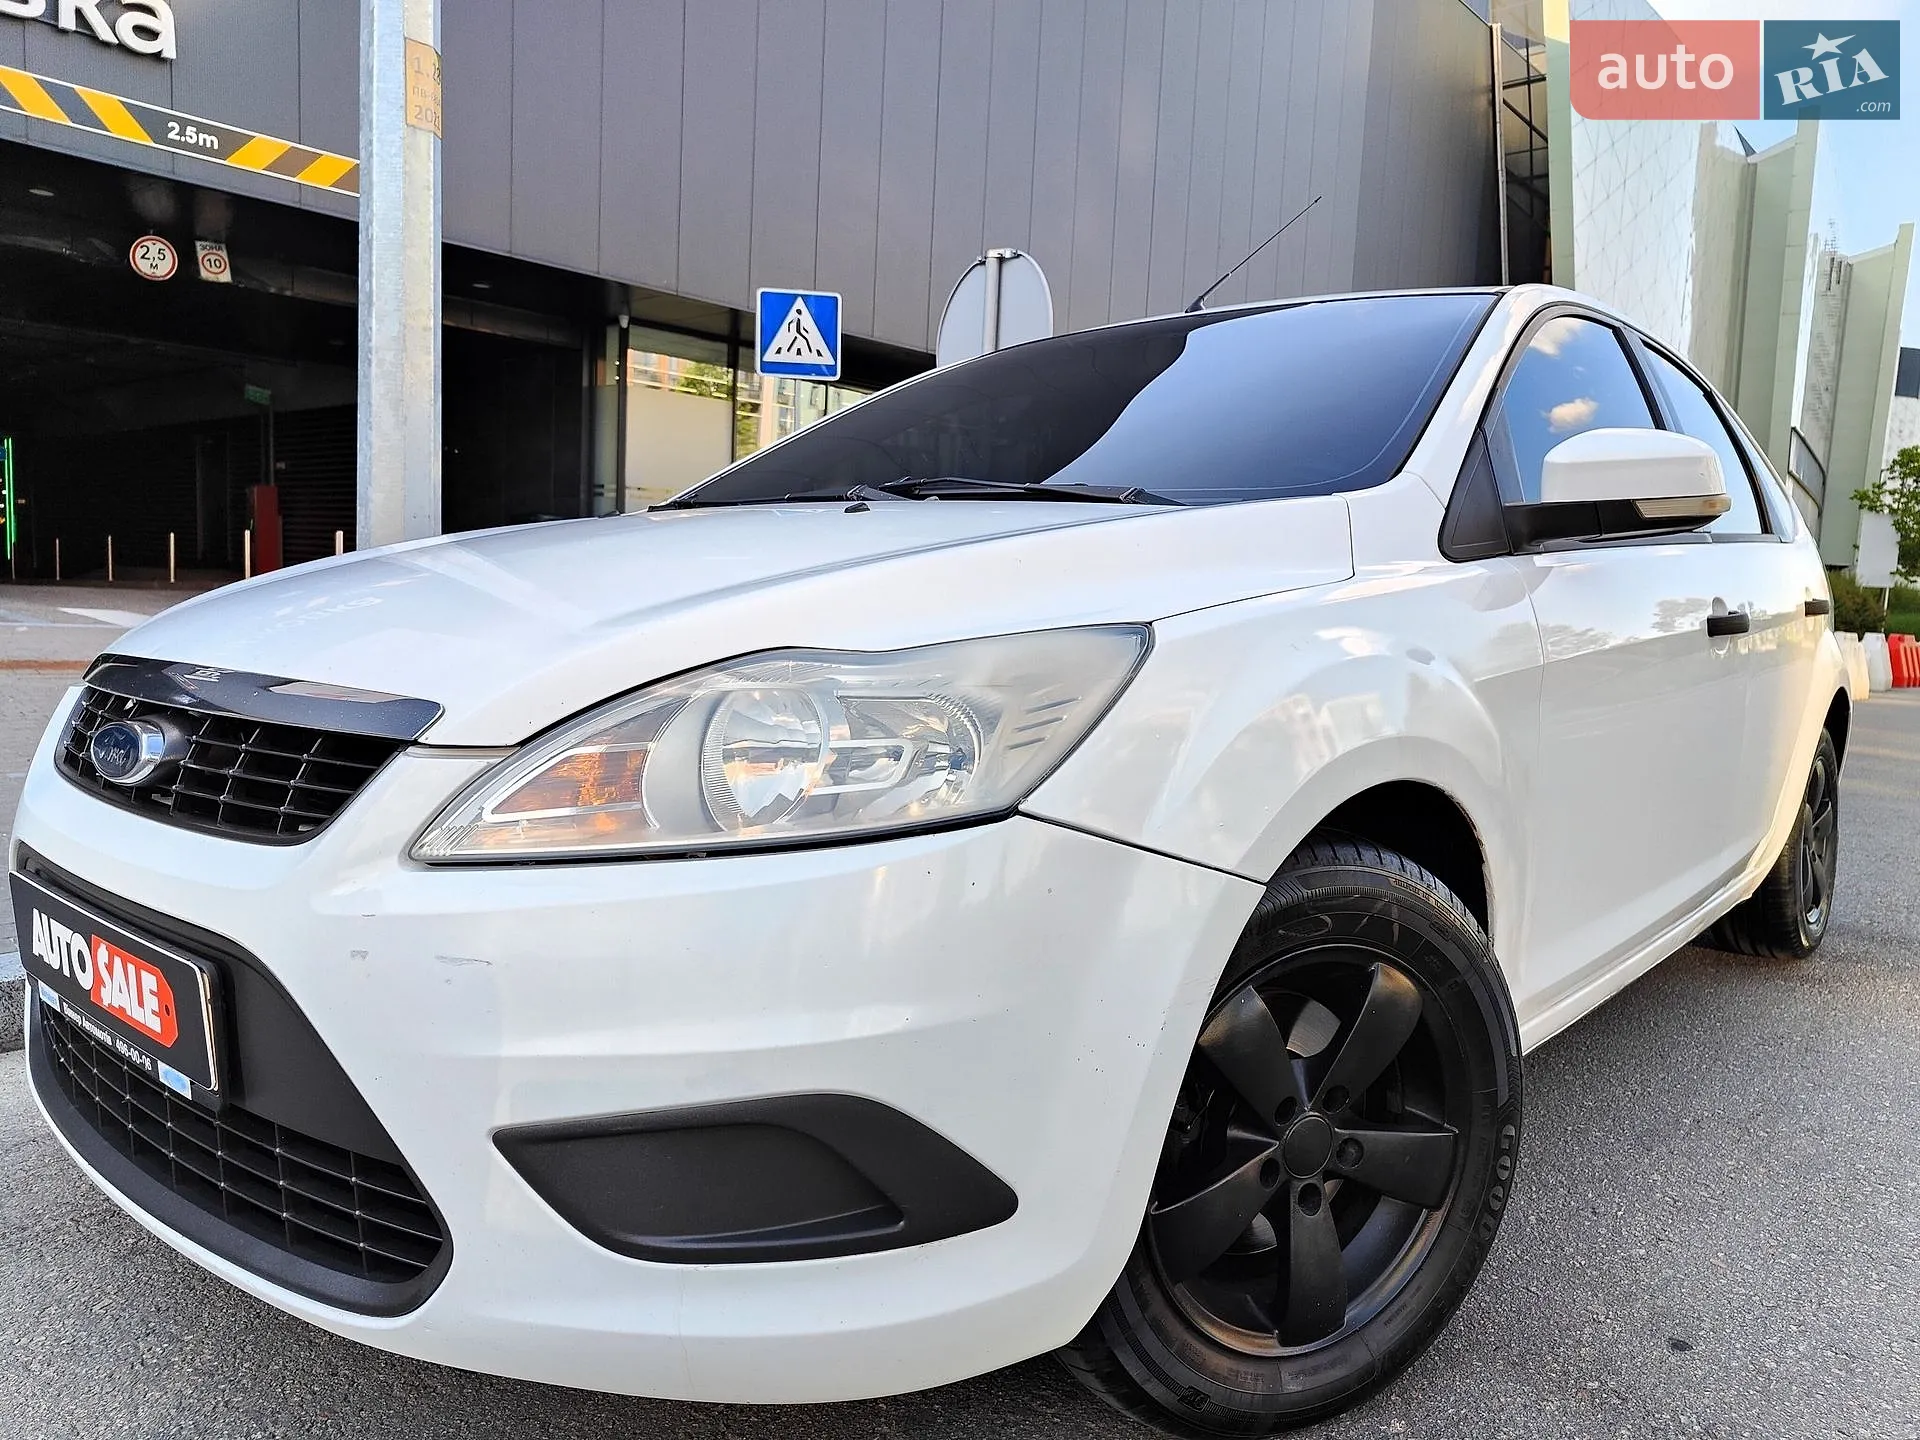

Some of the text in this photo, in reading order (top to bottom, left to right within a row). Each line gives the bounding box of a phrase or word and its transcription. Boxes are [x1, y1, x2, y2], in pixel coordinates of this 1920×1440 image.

[167, 121, 219, 150] 2.5m
[140, 244, 166, 262] 2,5
[206, 258, 222, 269] 10
[32, 907, 94, 991] AUTO
